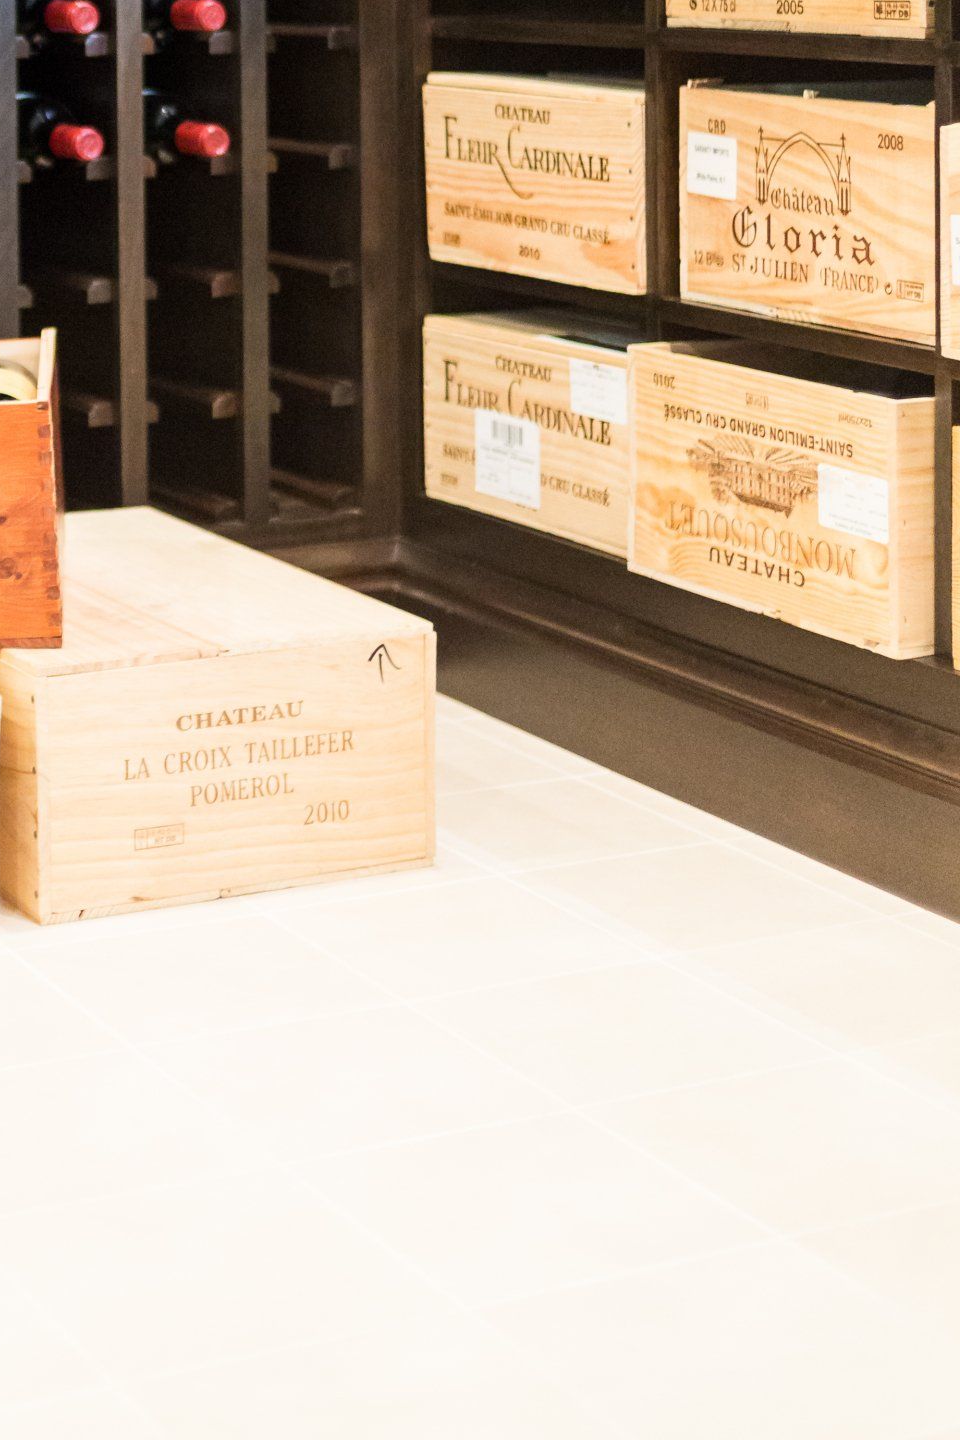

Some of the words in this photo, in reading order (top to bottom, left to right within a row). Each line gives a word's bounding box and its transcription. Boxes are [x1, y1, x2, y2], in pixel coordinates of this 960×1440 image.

[776, 0, 804, 15] 2005
[494, 103, 551, 125] CHATEAU
[507, 124, 610, 182] CARDINALE
[877, 133, 904, 151] 2008
[770, 187, 835, 216] Château
[514, 214, 548, 233] GRAND
[551, 221, 570, 238] CRU
[731, 205, 876, 266] Gloria
[820, 266, 879, 294] (FRANCE)
[495, 354, 552, 380] CHATEAU
[443, 359, 499, 413] FLEUR
[508, 379, 611, 446] CARDINALE
[664, 403, 702, 424] CLASSÉ
[705, 413, 727, 429] CRU
[730, 418, 766, 438] GRAND
[769, 426, 853, 459] SAINT-EMILION
[664, 500, 857, 581] MONBOUSQUET
[709, 547, 806, 588] CHATEAU
[175, 700, 304, 732] CHATEAU
[124, 756, 151, 781] LA
[163, 745, 232, 775] CROIX
[244, 729, 355, 765] TAILLEFER
[190, 773, 295, 808] POMEROL
[303, 799, 351, 826] 2010
